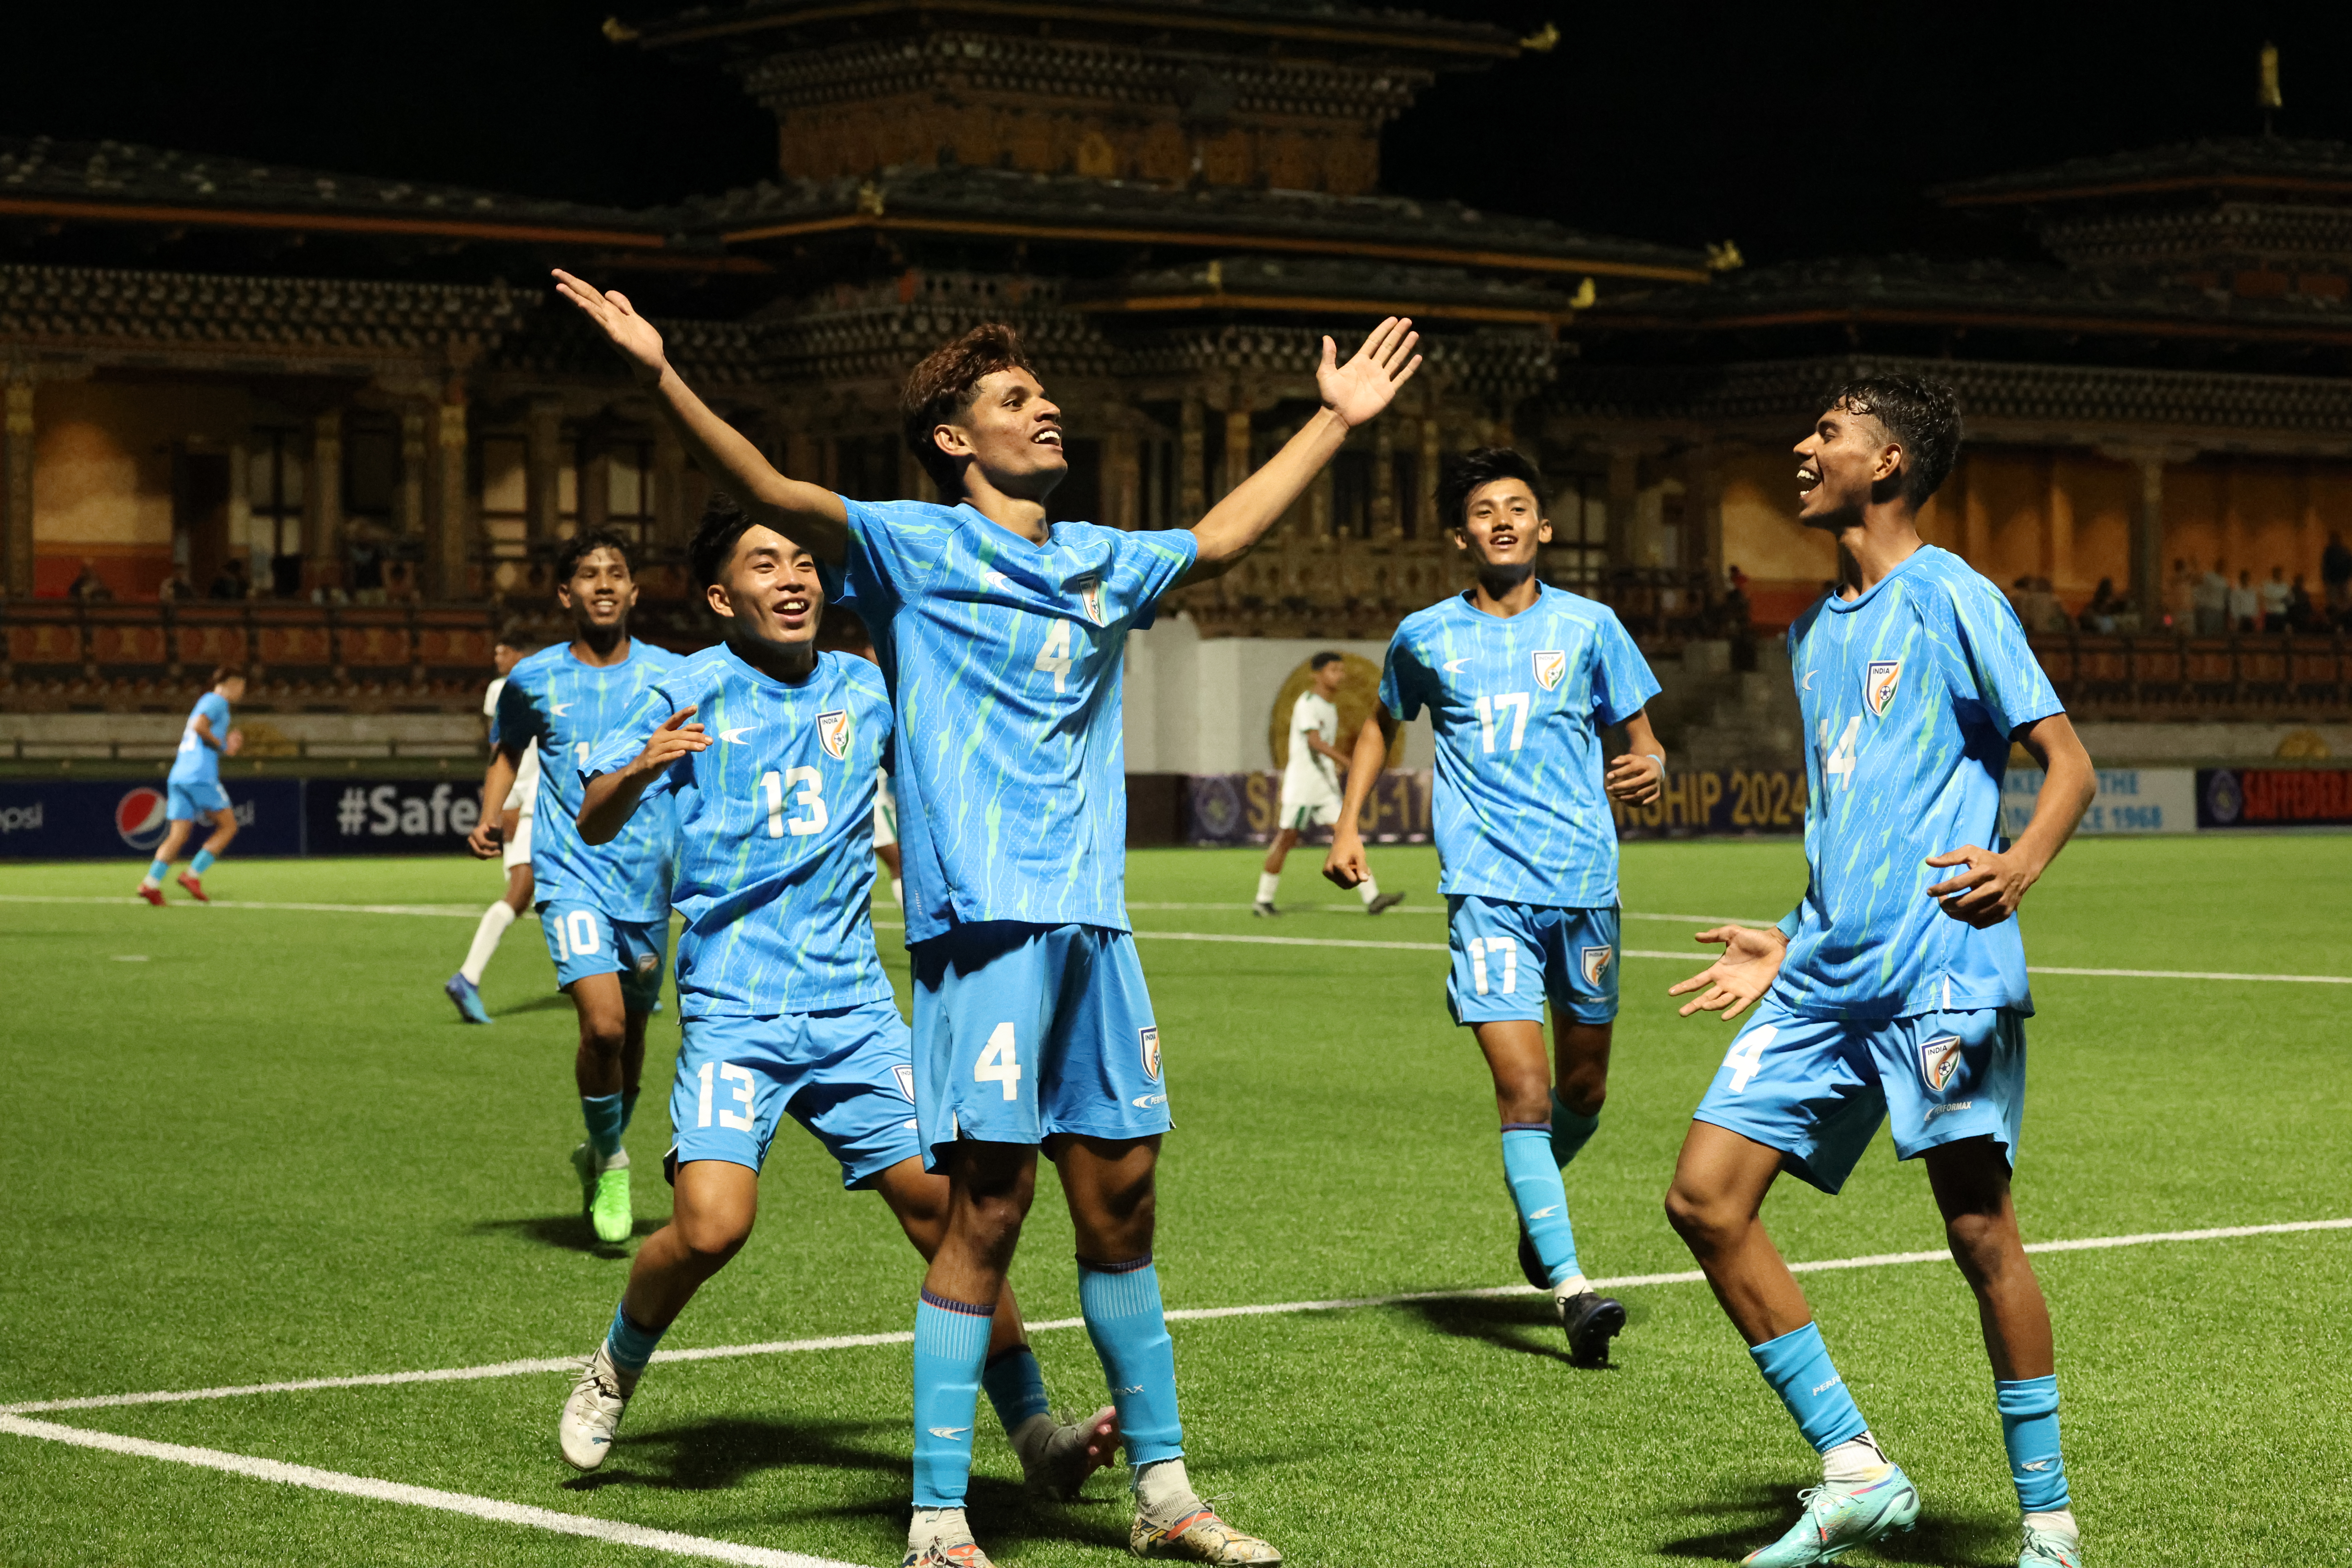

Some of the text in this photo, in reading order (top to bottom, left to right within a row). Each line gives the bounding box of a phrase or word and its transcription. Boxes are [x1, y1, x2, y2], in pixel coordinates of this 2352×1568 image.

[1033, 619, 1072, 693] 4
[1474, 692, 1529, 753] 17
[574, 742, 590, 790] 1
[1818, 716, 1860, 791] 14
[0, 802, 43, 834] psi
[336, 783, 485, 836] #Safe
[760, 766, 829, 838] 13
[554, 910, 600, 961] 10
[1468, 936, 1516, 995] 17
[974, 1022, 1021, 1100] 4
[1722, 1024, 1779, 1093] 4
[1927, 1045, 1947, 1055] INDIA
[697, 1061, 755, 1132] 13
